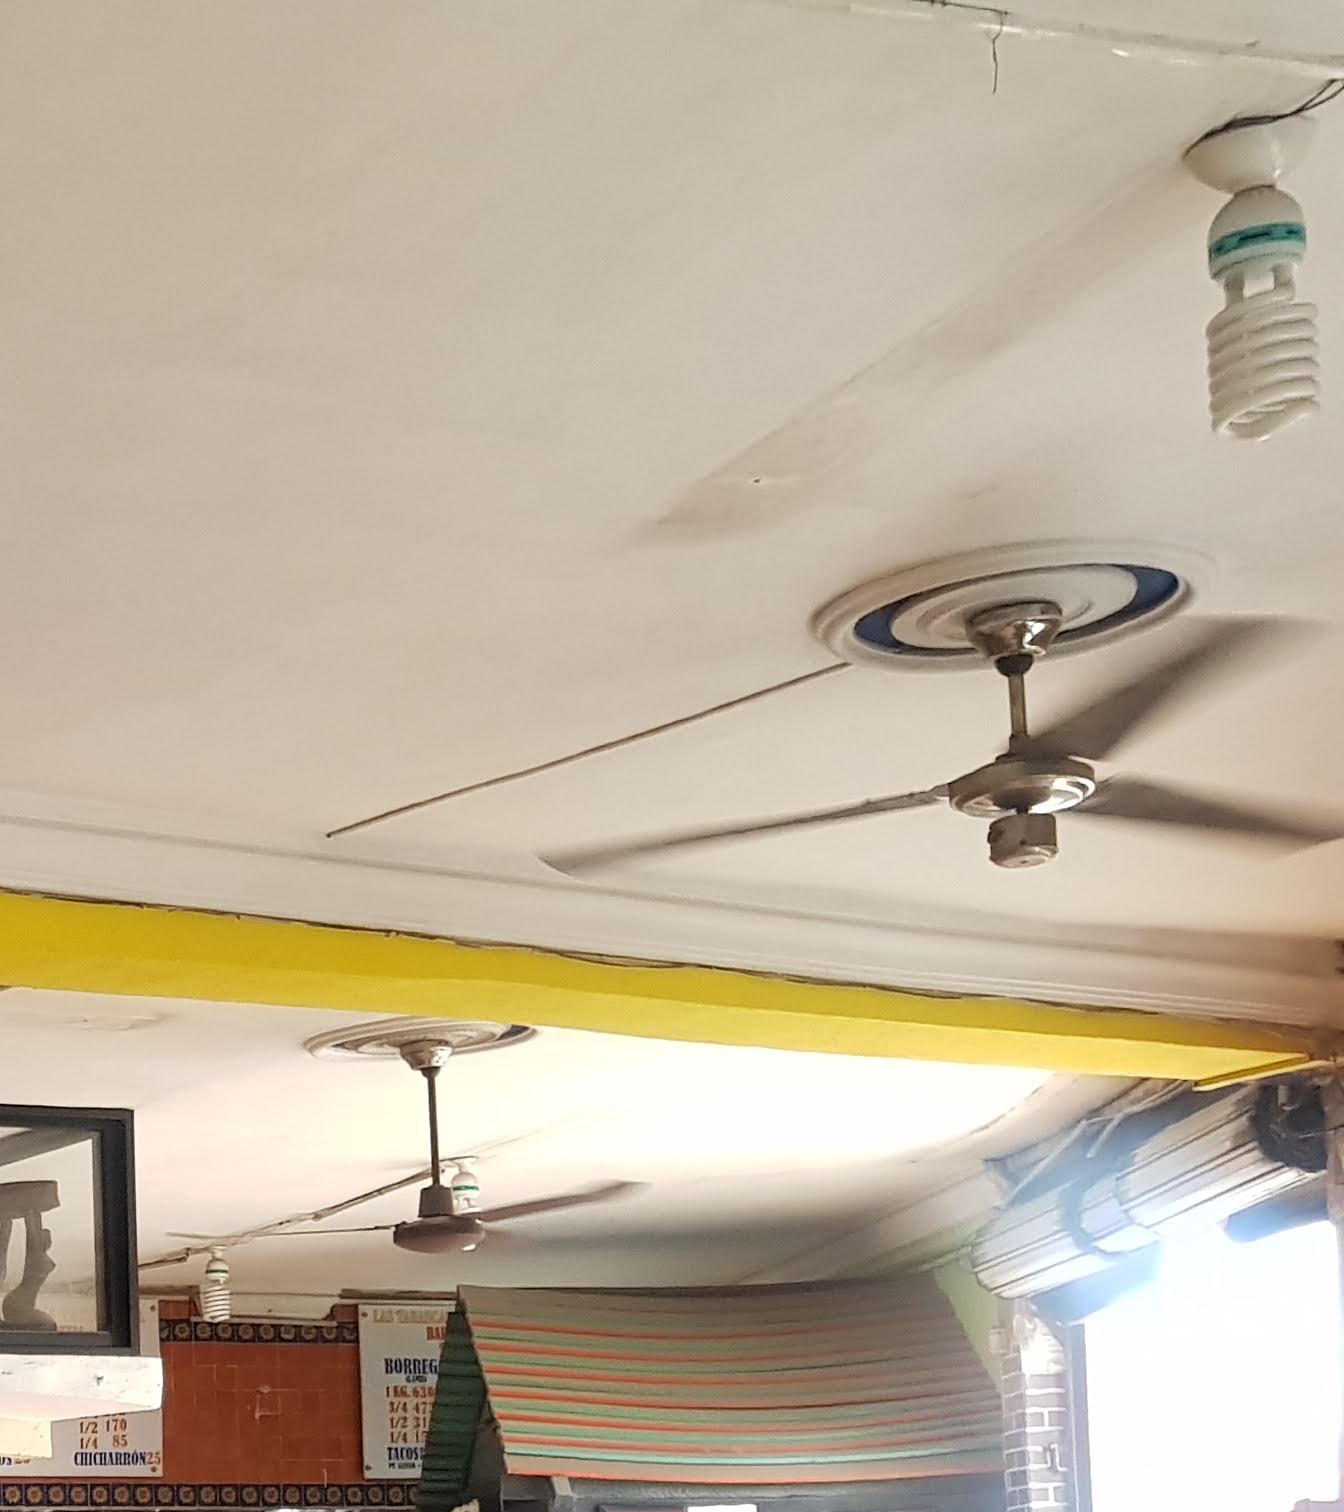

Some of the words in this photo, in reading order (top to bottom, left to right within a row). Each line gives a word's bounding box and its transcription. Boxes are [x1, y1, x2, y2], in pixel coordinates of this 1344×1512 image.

[384, 1357, 439, 1375] BORREG
[389, 1402, 408, 1414] 3/4
[79, 1421, 98, 1434] 1/2
[106, 1419, 127, 1433] 170
[390, 1417, 408, 1429] 1/2
[413, 1417, 427, 1429] 31
[80, 1437, 98, 1450] 1/4
[113, 1435, 128, 1448] 85
[390, 1432, 408, 1444] 1/4
[74, 1450, 146, 1466] CHICHARRÓN
[147, 1452, 161, 1465] 25
